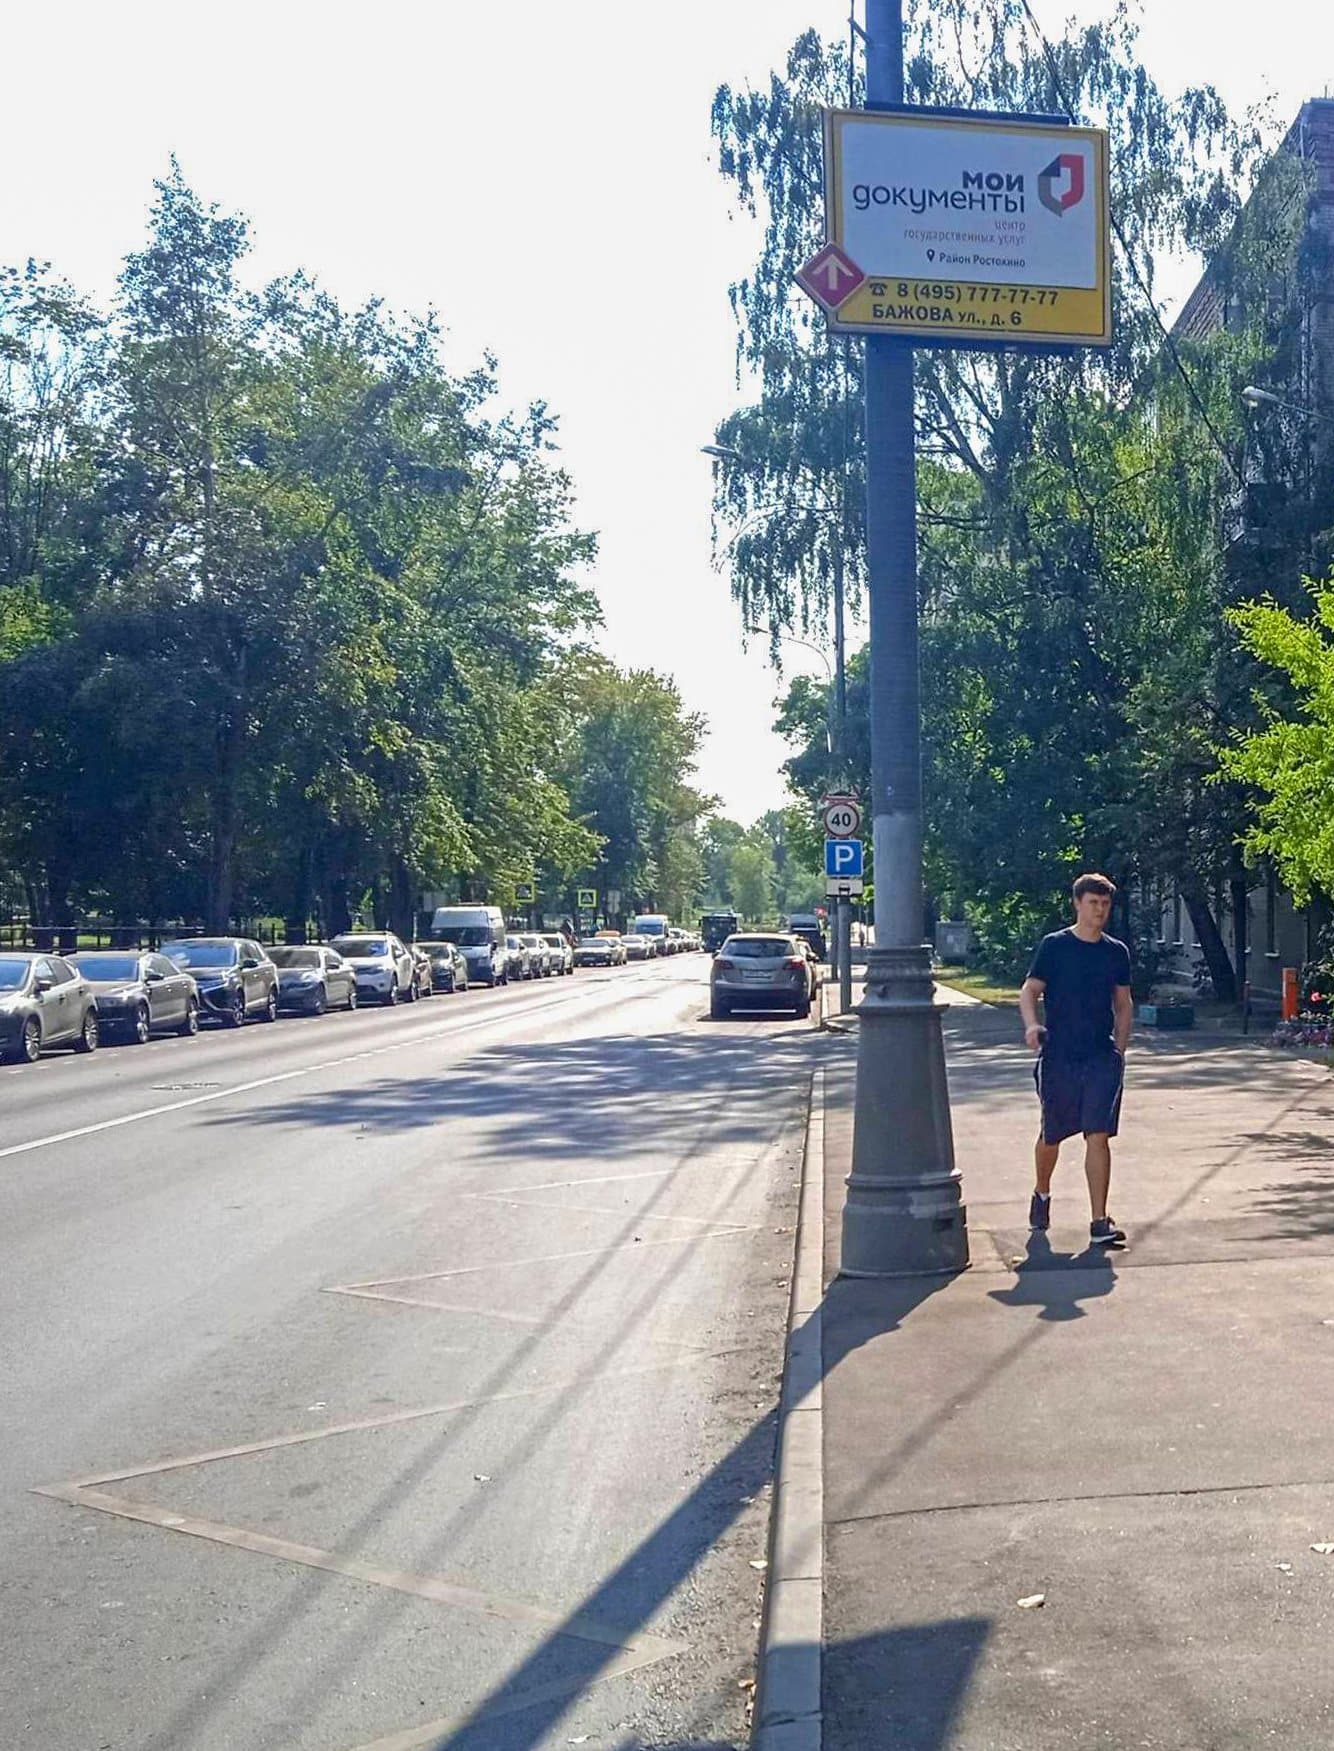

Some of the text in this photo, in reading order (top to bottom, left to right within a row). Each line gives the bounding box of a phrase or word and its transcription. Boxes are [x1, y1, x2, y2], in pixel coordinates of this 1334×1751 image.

[962, 170, 1024, 193] мои
[852, 183, 1025, 214] документы
[903, 228, 1025, 245] государственных услуг
[995, 221, 1026, 232] центр
[939, 251, 1026, 268] Район Ростокино
[897, 282, 1059, 306] 8 (495) 777-77-77
[872, 303, 954, 322] БАЖОВА
[990, 314, 1006, 326] д.
[1010, 310, 1022, 325] 6
[831, 812, 851, 827] 40
[834, 845, 854, 872] P
